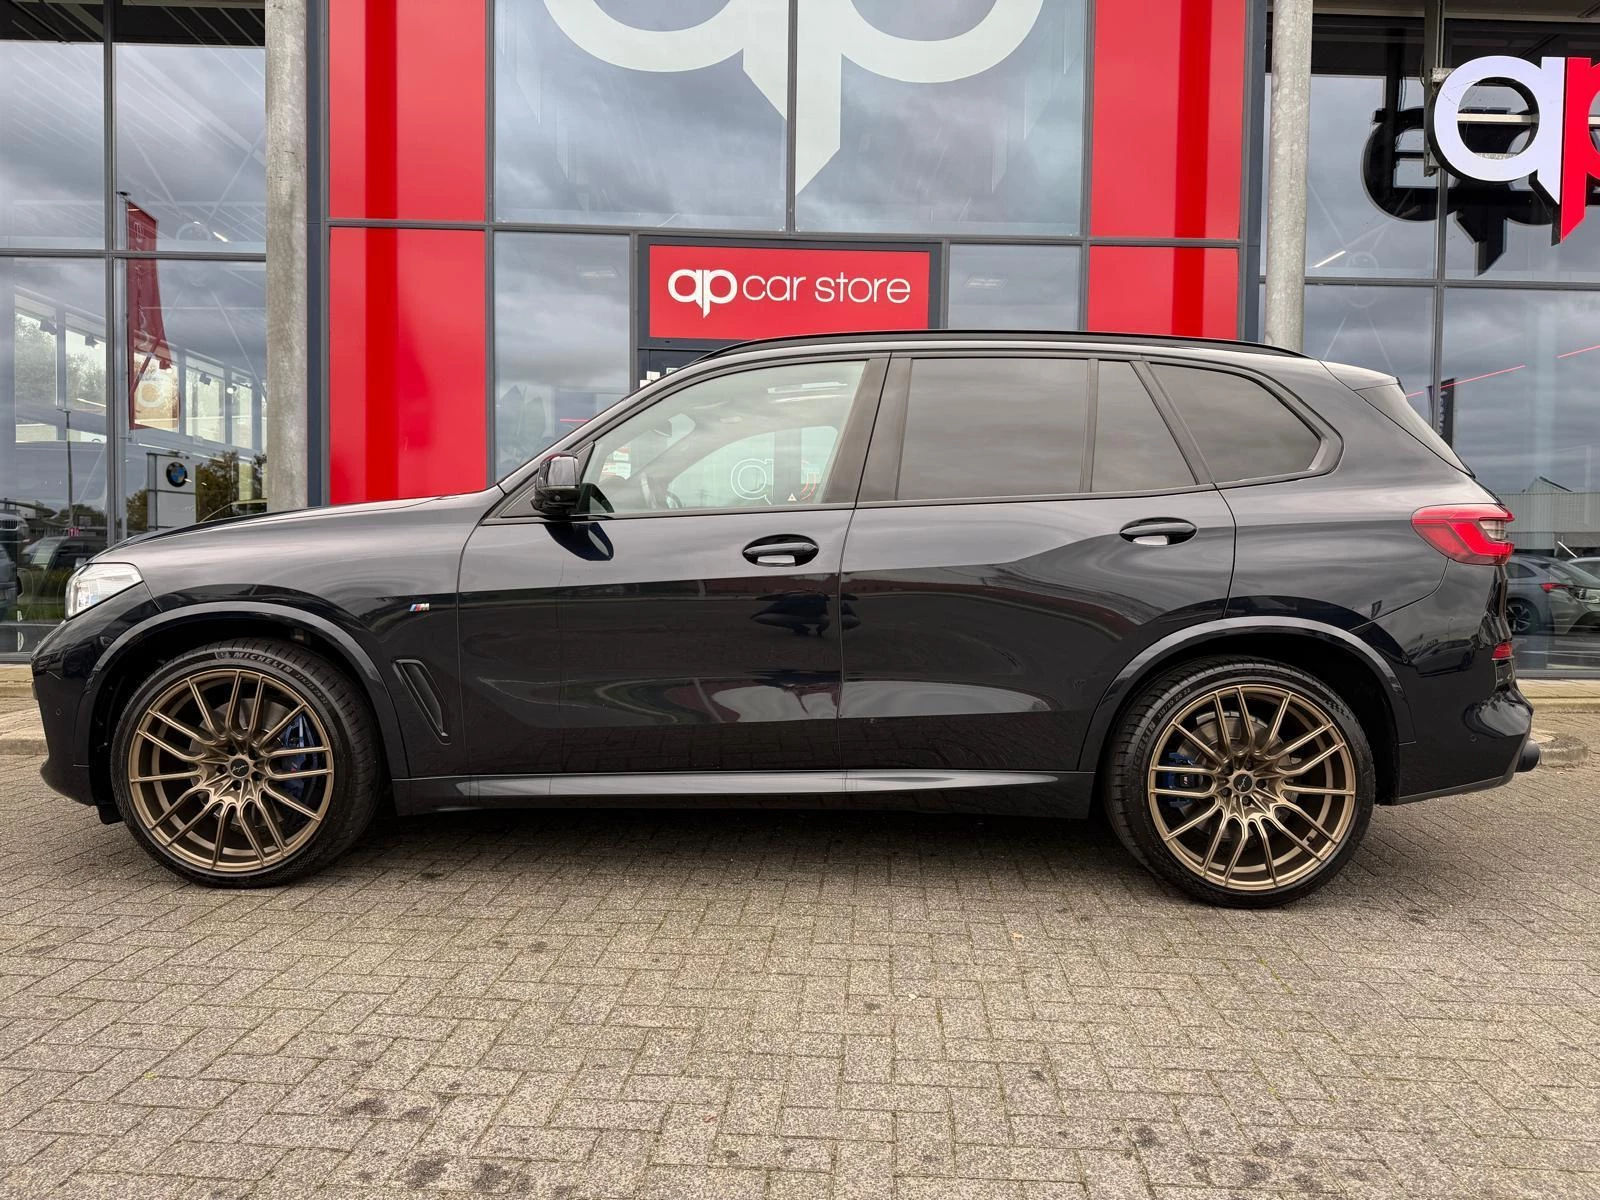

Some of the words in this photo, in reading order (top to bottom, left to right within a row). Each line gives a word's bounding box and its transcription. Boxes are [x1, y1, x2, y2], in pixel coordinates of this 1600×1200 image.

[668, 269, 738, 318] ap
[742, 275, 806, 301] car
[814, 272, 911, 304] store
[233, 652, 293, 673] MICHELIN
